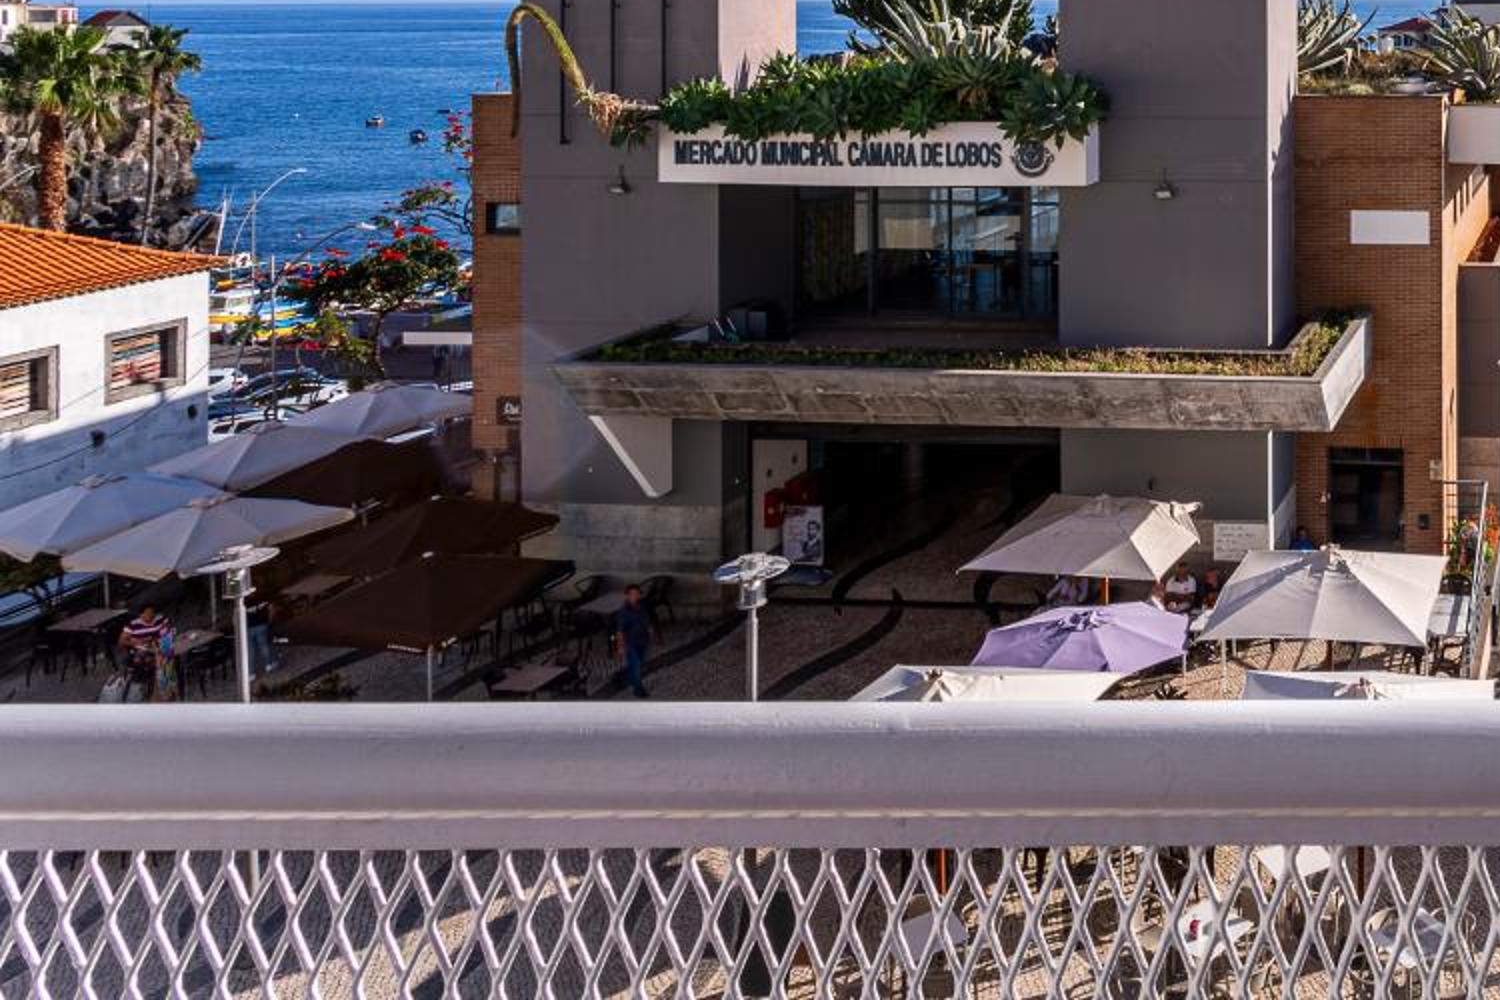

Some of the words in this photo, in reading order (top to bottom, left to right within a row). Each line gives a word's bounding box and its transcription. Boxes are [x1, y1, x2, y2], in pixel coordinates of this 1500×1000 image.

[674, 139, 758, 166] MERCADO
[761, 140, 843, 167] MUNICIPAL
[921, 141, 944, 168] DE
[946, 141, 1002, 169] LOBOS
